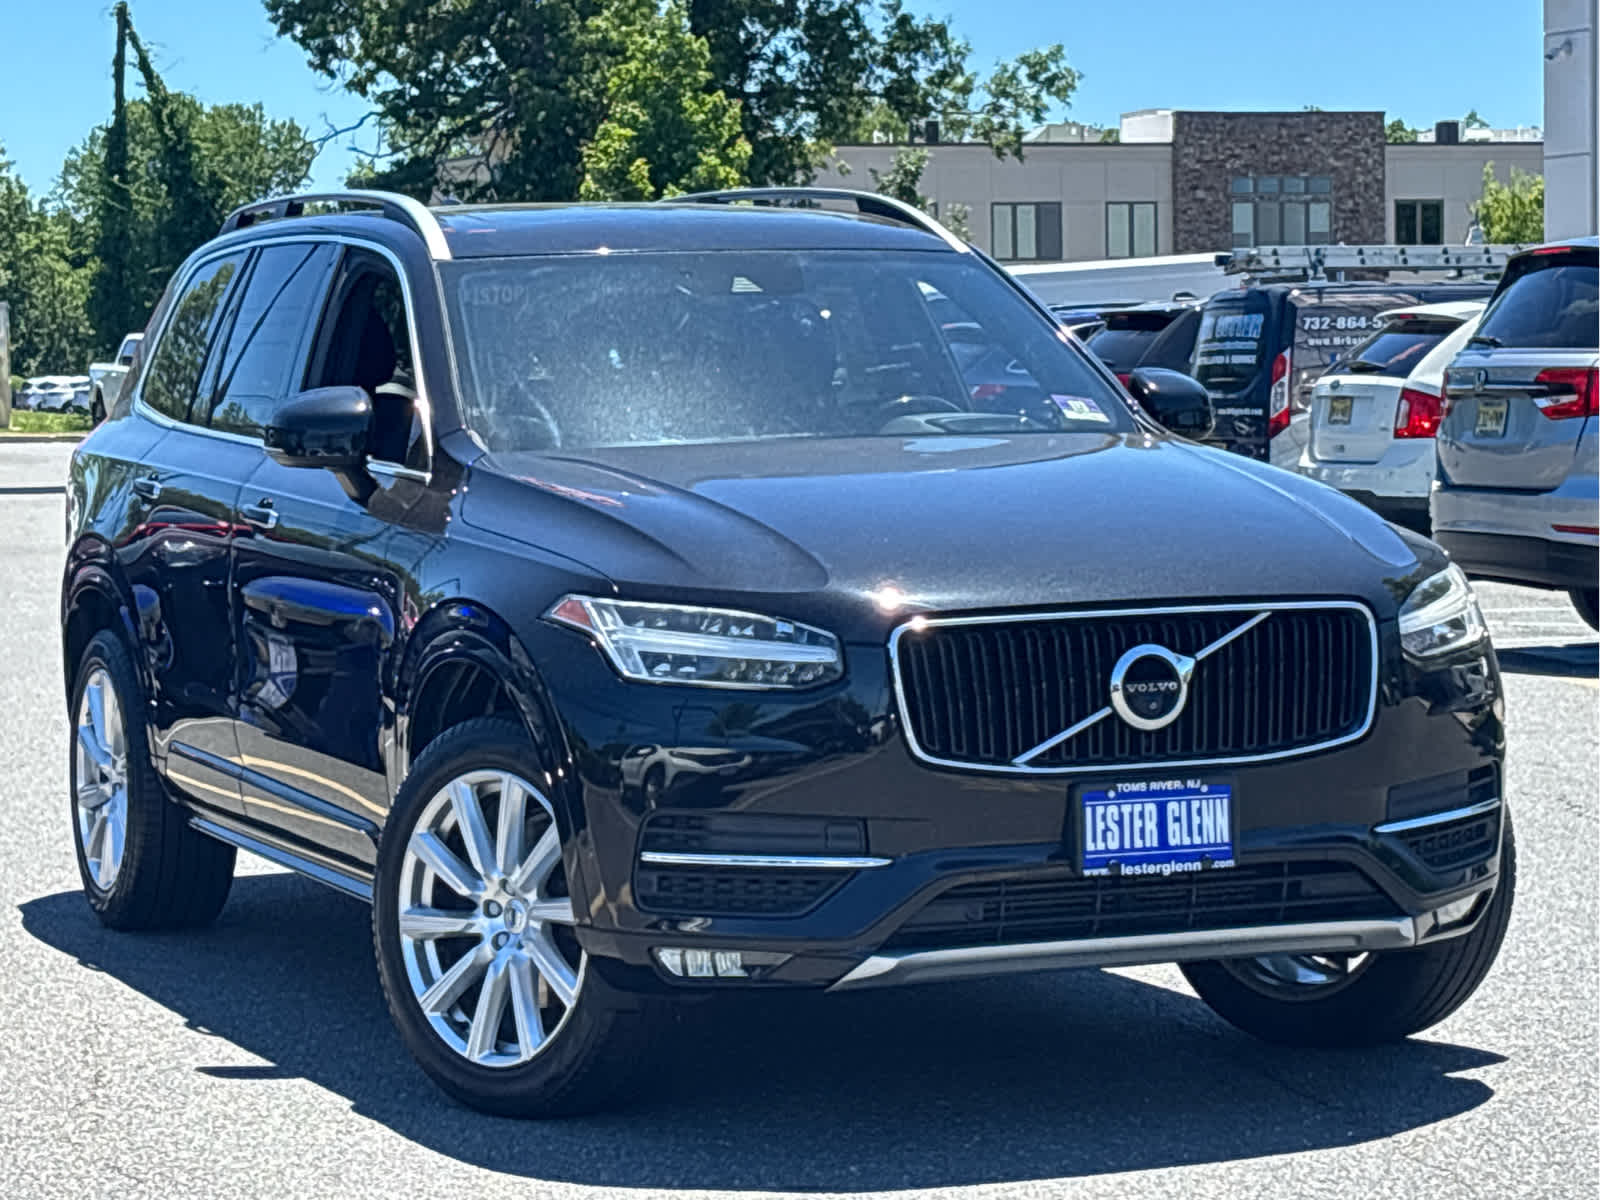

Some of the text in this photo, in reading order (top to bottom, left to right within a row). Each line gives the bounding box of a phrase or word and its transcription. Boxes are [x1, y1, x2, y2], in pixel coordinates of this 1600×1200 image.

[1303, 316, 1388, 330] 732-864-5
[1126, 682, 1178, 693] VOLVO
[1116, 782, 1147, 793] TOMS
[1187, 779, 1200, 789] NJ
[1085, 798, 1230, 851] LESTER GLENN
[1121, 861, 1202, 876] lesterglenn
